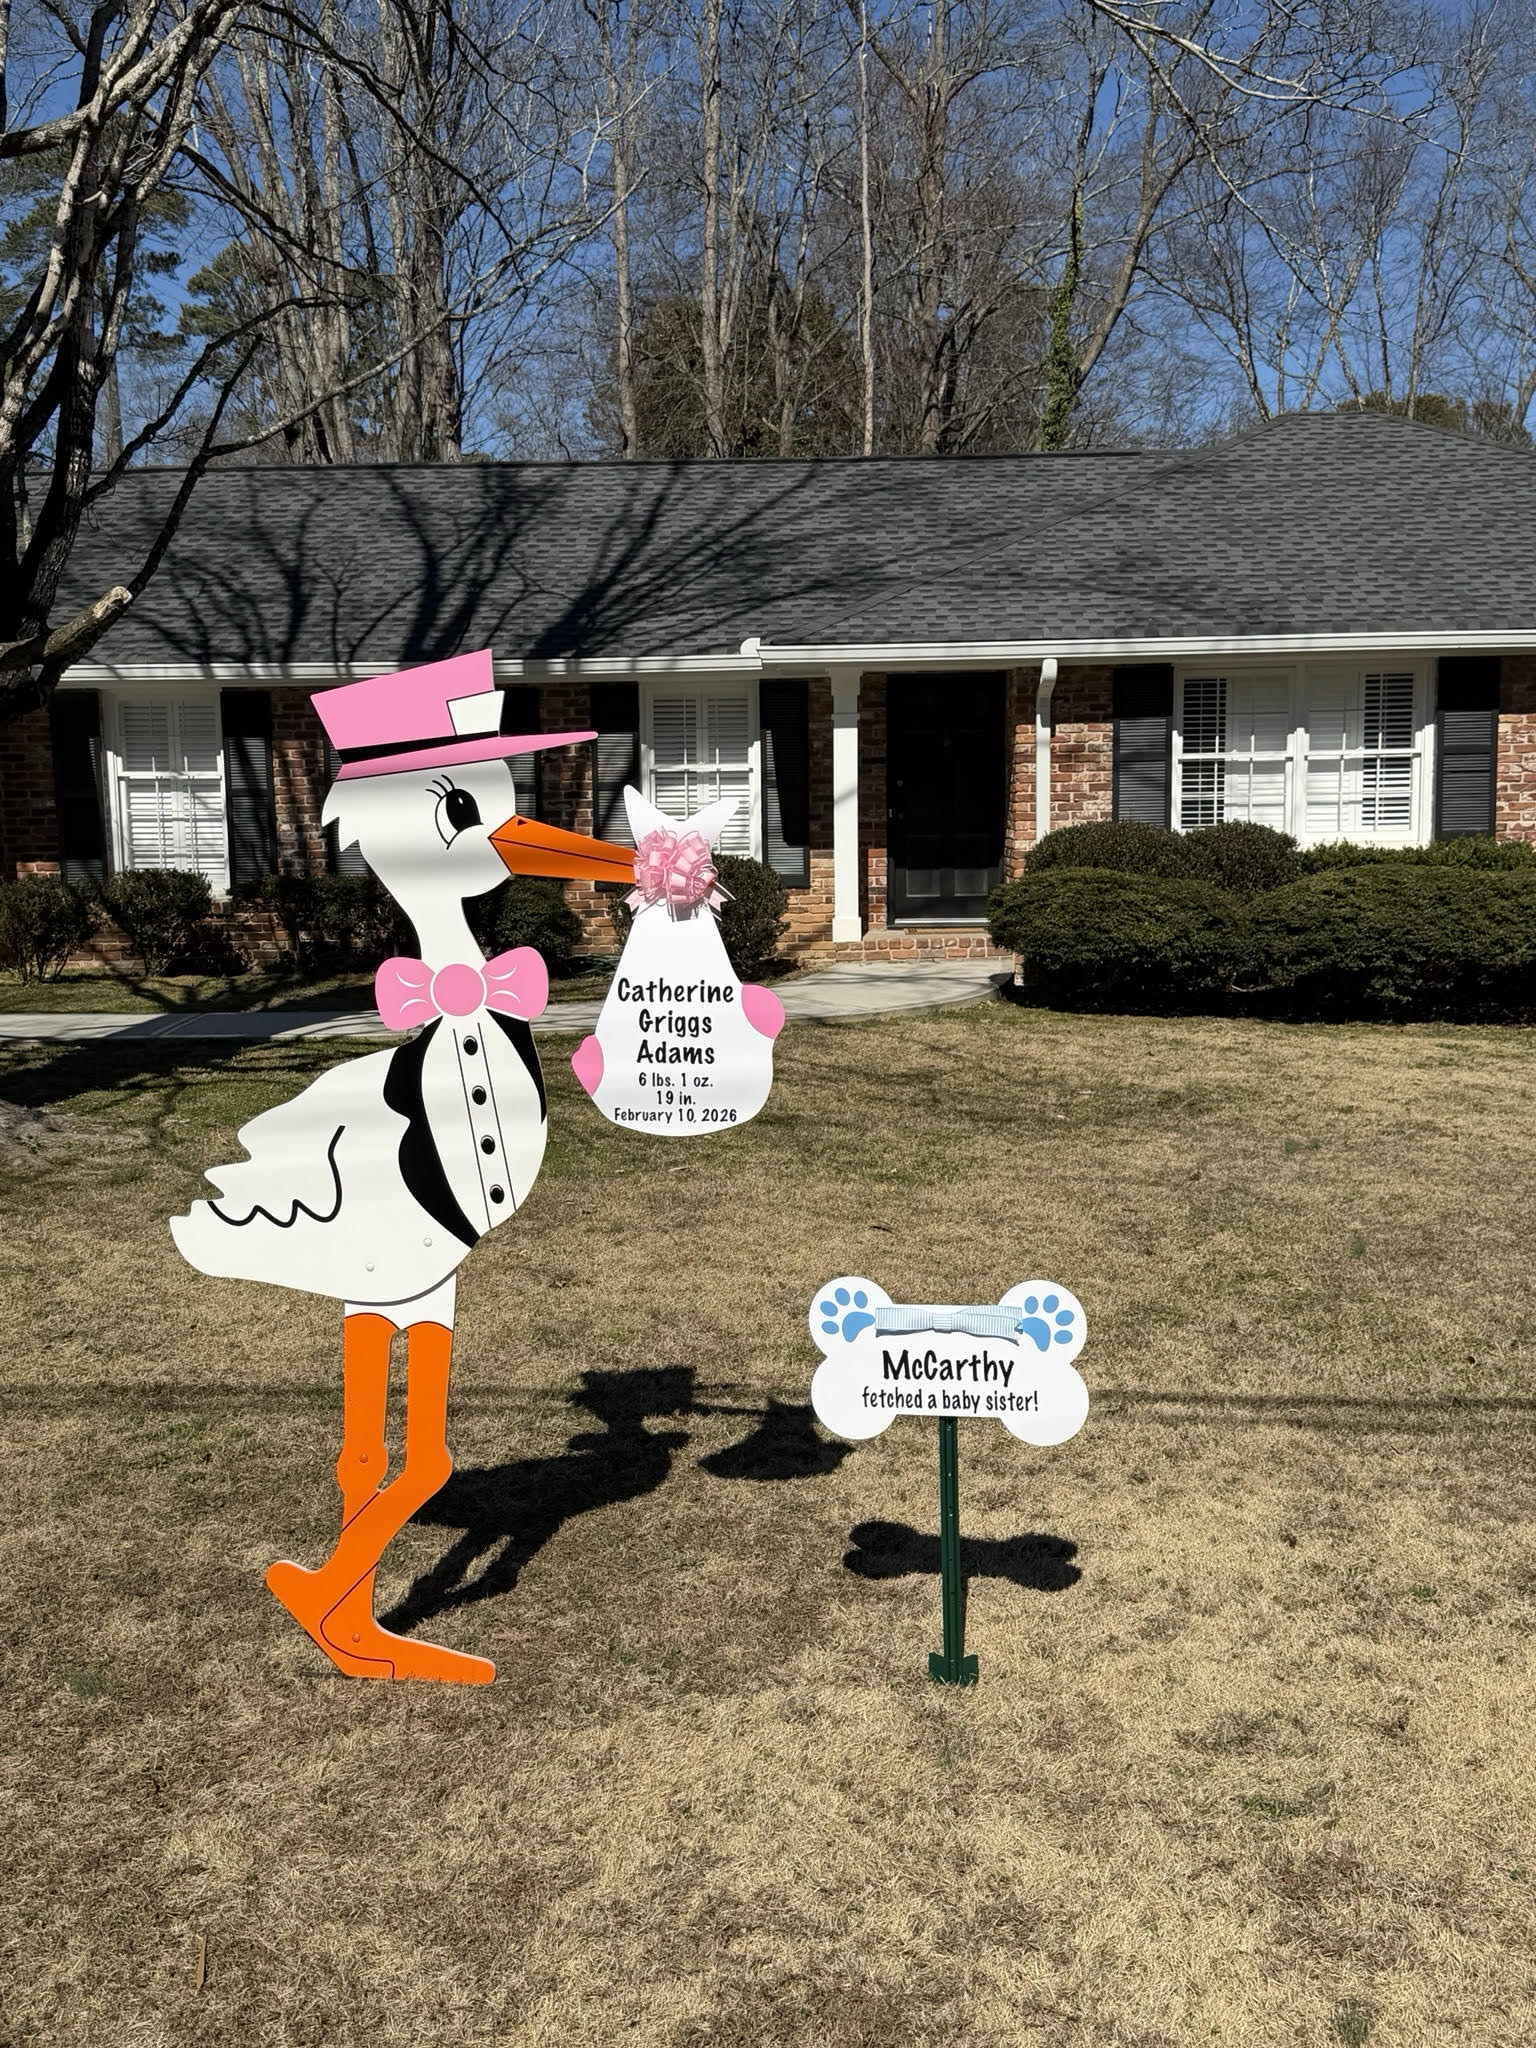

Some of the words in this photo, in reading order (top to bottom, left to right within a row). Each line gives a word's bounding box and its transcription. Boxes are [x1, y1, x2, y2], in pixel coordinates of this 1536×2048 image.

[618, 978, 733, 1003] Catherine
[639, 1009, 712, 1038] Griggs
[637, 1040, 714, 1064] Adams
[639, 1072, 646, 1086] 6
[653, 1072, 674, 1087] lbs.
[681, 1073, 686, 1087] 1
[694, 1077, 713, 1087] oz.
[657, 1090, 673, 1105] 19
[680, 1092, 695, 1105] in.
[614, 1108, 672, 1124] February
[679, 1108, 696, 1123] 10,
[701, 1109, 736, 1122] 2026
[883, 1350, 1014, 1388] McCarthy
[862, 1386, 922, 1408] fetched
[928, 1394, 937, 1409] a
[943, 1389, 980, 1414] baby
[986, 1390, 1038, 1411] sister!
